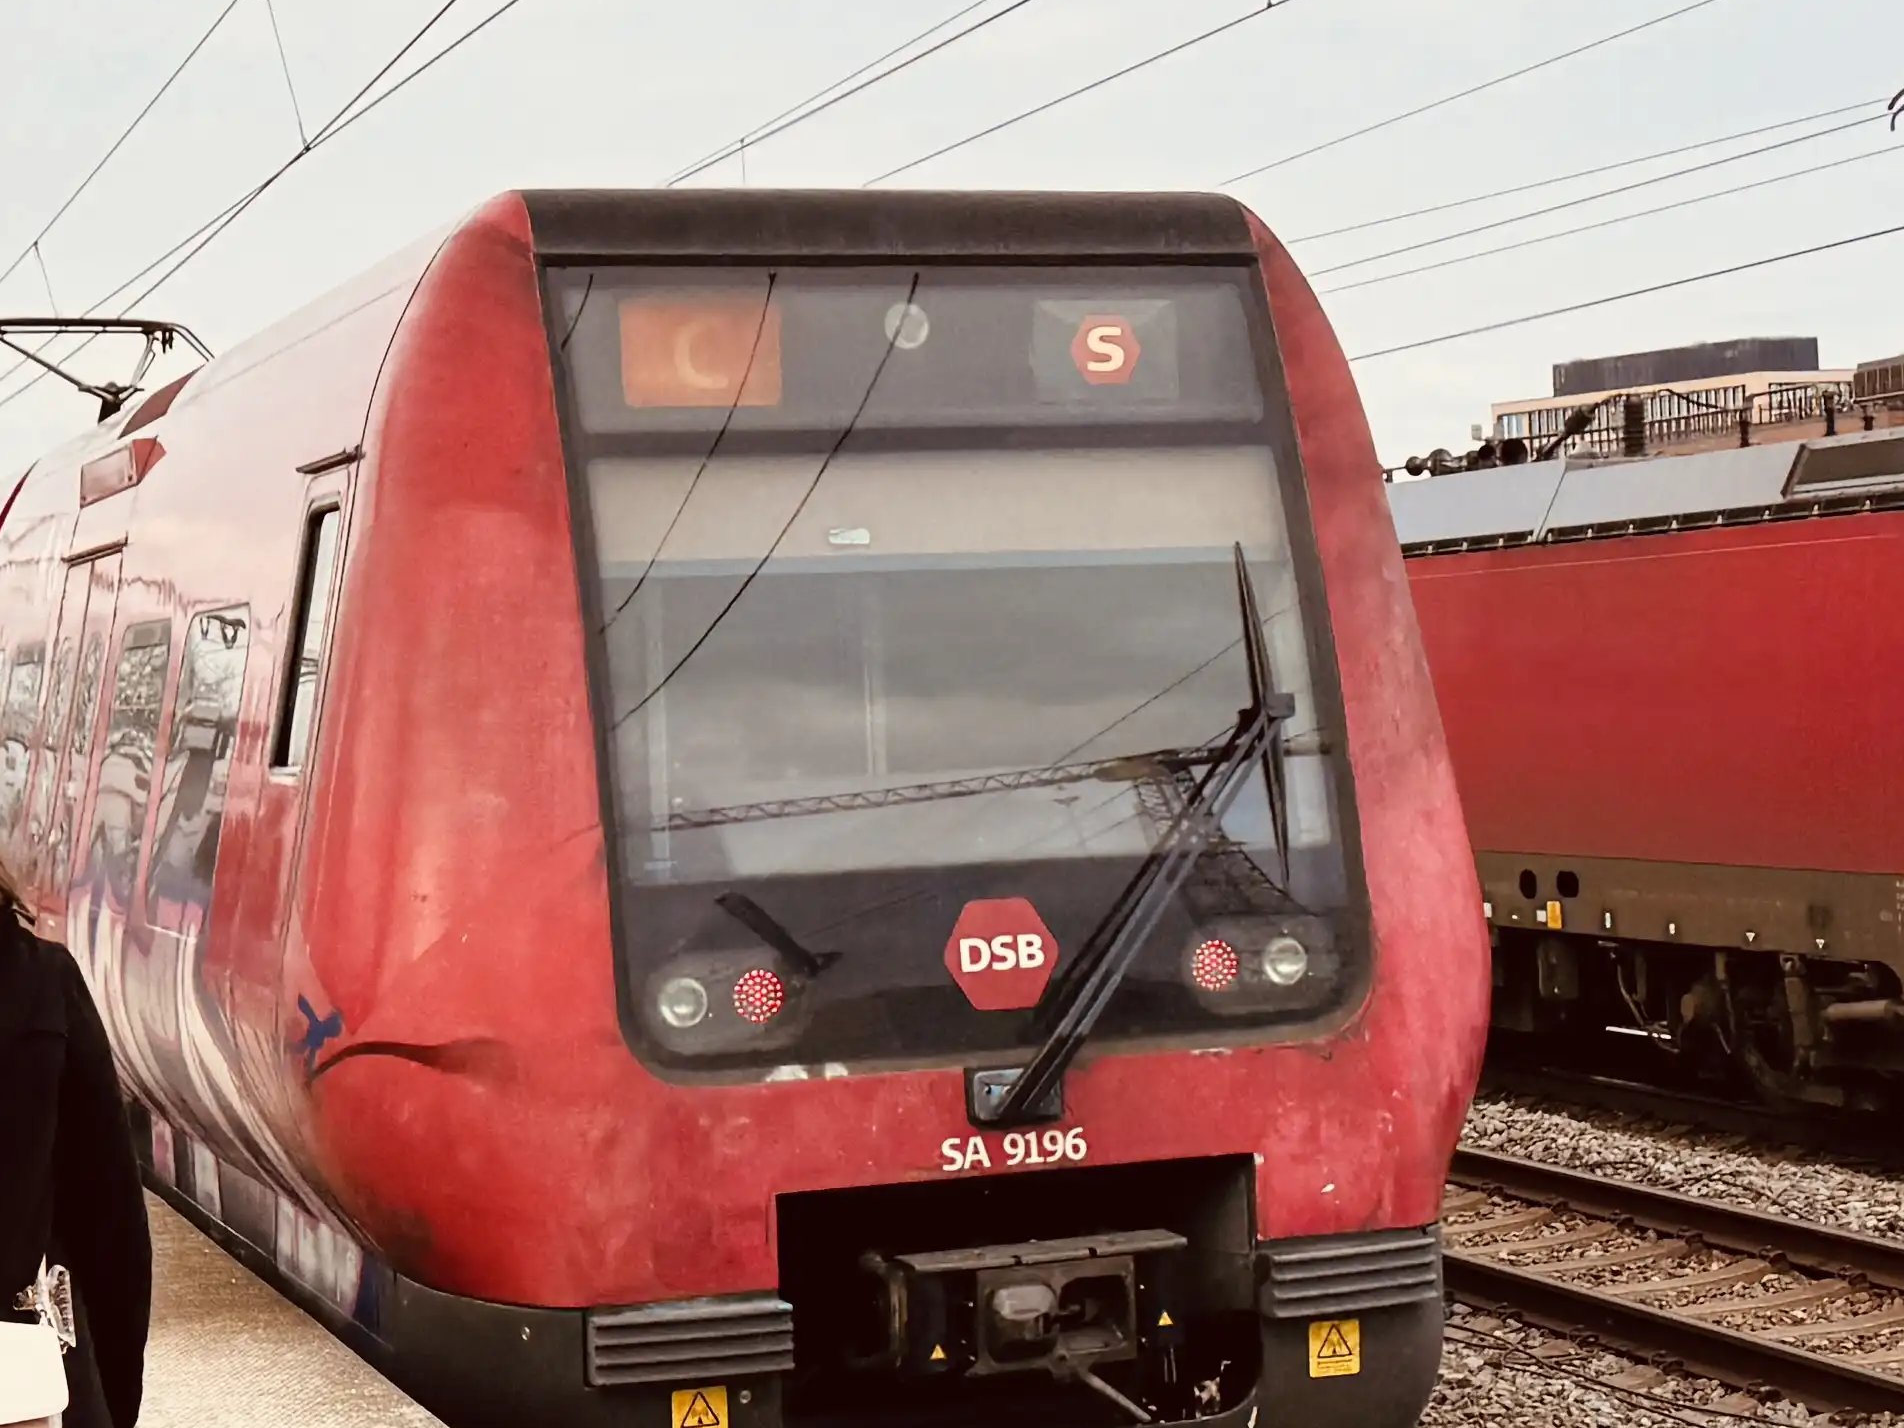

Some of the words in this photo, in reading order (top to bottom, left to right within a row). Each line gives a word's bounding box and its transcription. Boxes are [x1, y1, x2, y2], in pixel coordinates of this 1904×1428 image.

[673, 320, 730, 390] C
[1085, 325, 1125, 372] S
[959, 933, 1045, 973] DSB
[941, 1135, 991, 1172] SA
[1003, 1127, 1088, 1166] 9196
